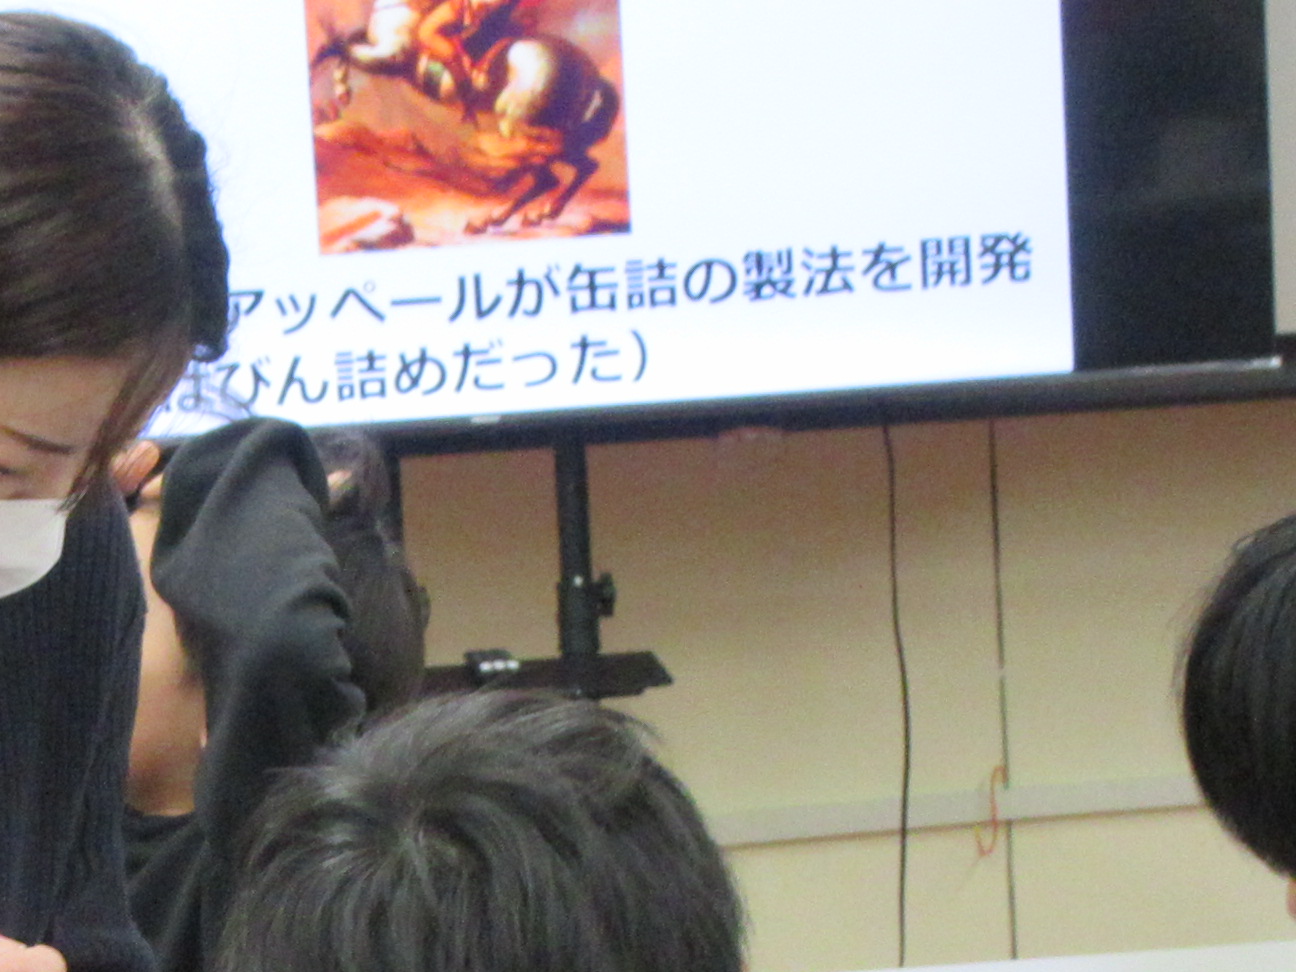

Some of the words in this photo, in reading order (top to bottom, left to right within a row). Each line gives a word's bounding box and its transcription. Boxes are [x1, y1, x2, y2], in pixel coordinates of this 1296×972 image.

[228, 231, 1032, 335] アッペールが缶詰の製法を開発
